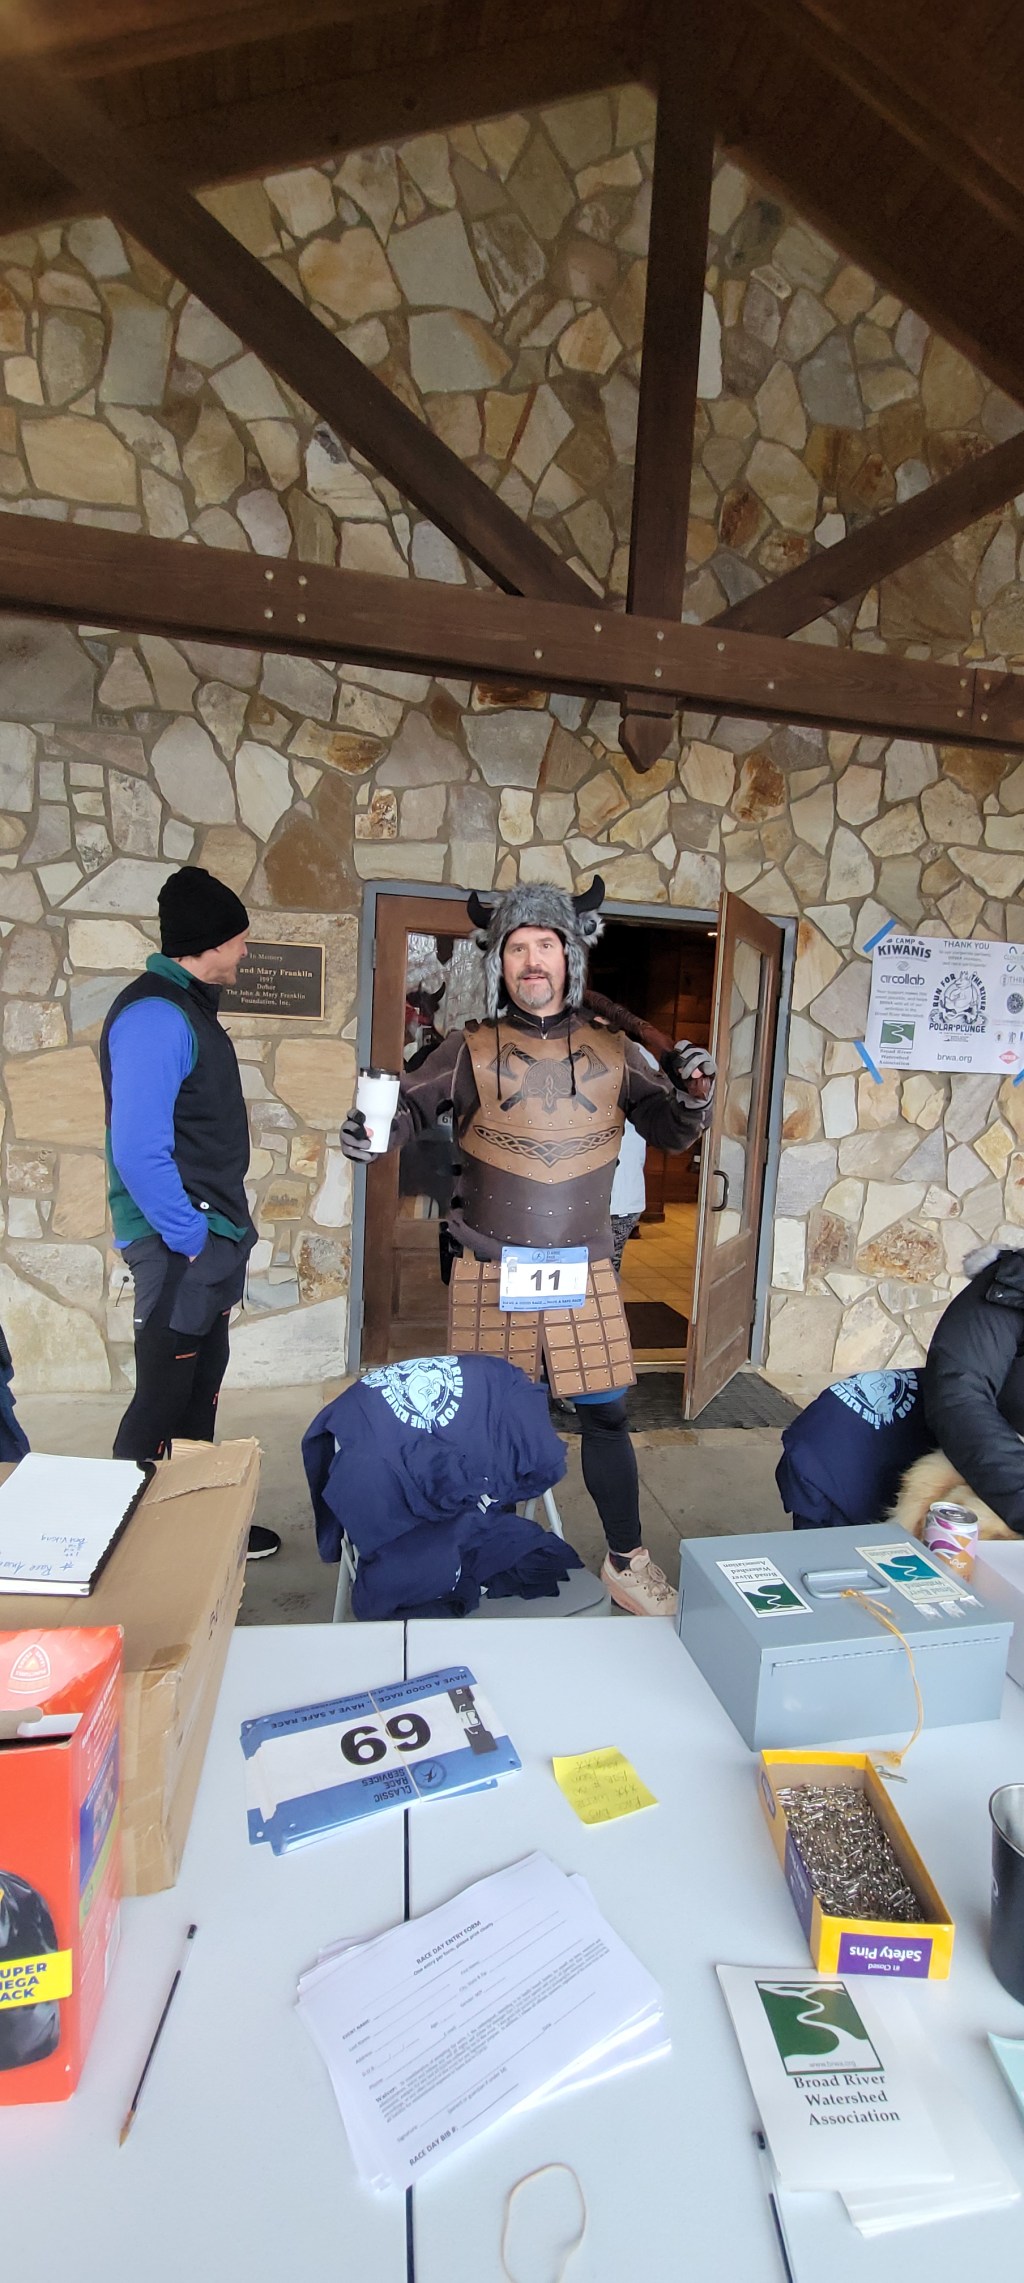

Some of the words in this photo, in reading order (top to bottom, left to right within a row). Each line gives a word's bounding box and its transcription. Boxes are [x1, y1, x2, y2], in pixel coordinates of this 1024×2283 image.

[895, 937, 916, 945] CAMP
[944, 940, 973, 949] THANK
[974, 942, 990, 950] YOU
[877, 944, 932, 959] KIWANIS
[256, 967, 277, 977] Mary
[280, 969, 313, 978] Franklin
[880, 973, 925, 986] arcollab
[262, 991, 278, 999] Mary
[932, 987, 943, 1008] RUN
[940, 973, 956, 987] FOR
[971, 973, 983, 987] THE
[979, 986, 987, 1011] RIVER
[929, 1022, 954, 1032] POLAR
[955, 1024, 986, 1033] PLUNGE
[937, 1052, 973, 1063] brwa.org
[530, 1269, 560, 1291] 11
[451, 1366, 464, 1398] RUN
[381, 1386, 410, 1424] RIVER
[896, 1392, 916, 1419] FOR
[437, 1400, 460, 1427] FOR
[861, 1408, 881, 1426] THE
[444, 1673, 468, 1684] HAVE
[406, 1683, 432, 1695] GOOD
[379, 1692, 404, 1703] RACE
[339, 1703, 365, 1713] HAVE
[271, 1718, 298, 1729] RACE
[302, 1712, 327, 1723] SAFE
[340, 1713, 431, 1766] 69
[361, 1768, 405, 1787] SERVICES
[385, 1776, 409, 1790] RACE
[373, 1784, 412, 1803] CLASSIC
[416, 1951, 433, 1965] RACE
[432, 1943, 445, 1954] DAY
[445, 1931, 464, 1946] ENTRY
[463, 1920, 481, 1934] FORM
[849, 1946, 878, 1960] Pins
[879, 1945, 923, 1962] Safety
[0, 1962, 48, 1979] UPER
[867, 1963, 892, 1971] Closed
[0, 1975, 40, 1990] EGA
[0, 1987, 35, 2002] ACK
[793, 2074, 840, 2089] Broad
[842, 2073, 886, 2086] River
[804, 2089, 889, 2107] Watershed
[809, 2108, 901, 2126] Association
[409, 2149, 427, 2166] RACE
[426, 2138, 440, 2153] DAY
[440, 2129, 452, 2142] BIB
